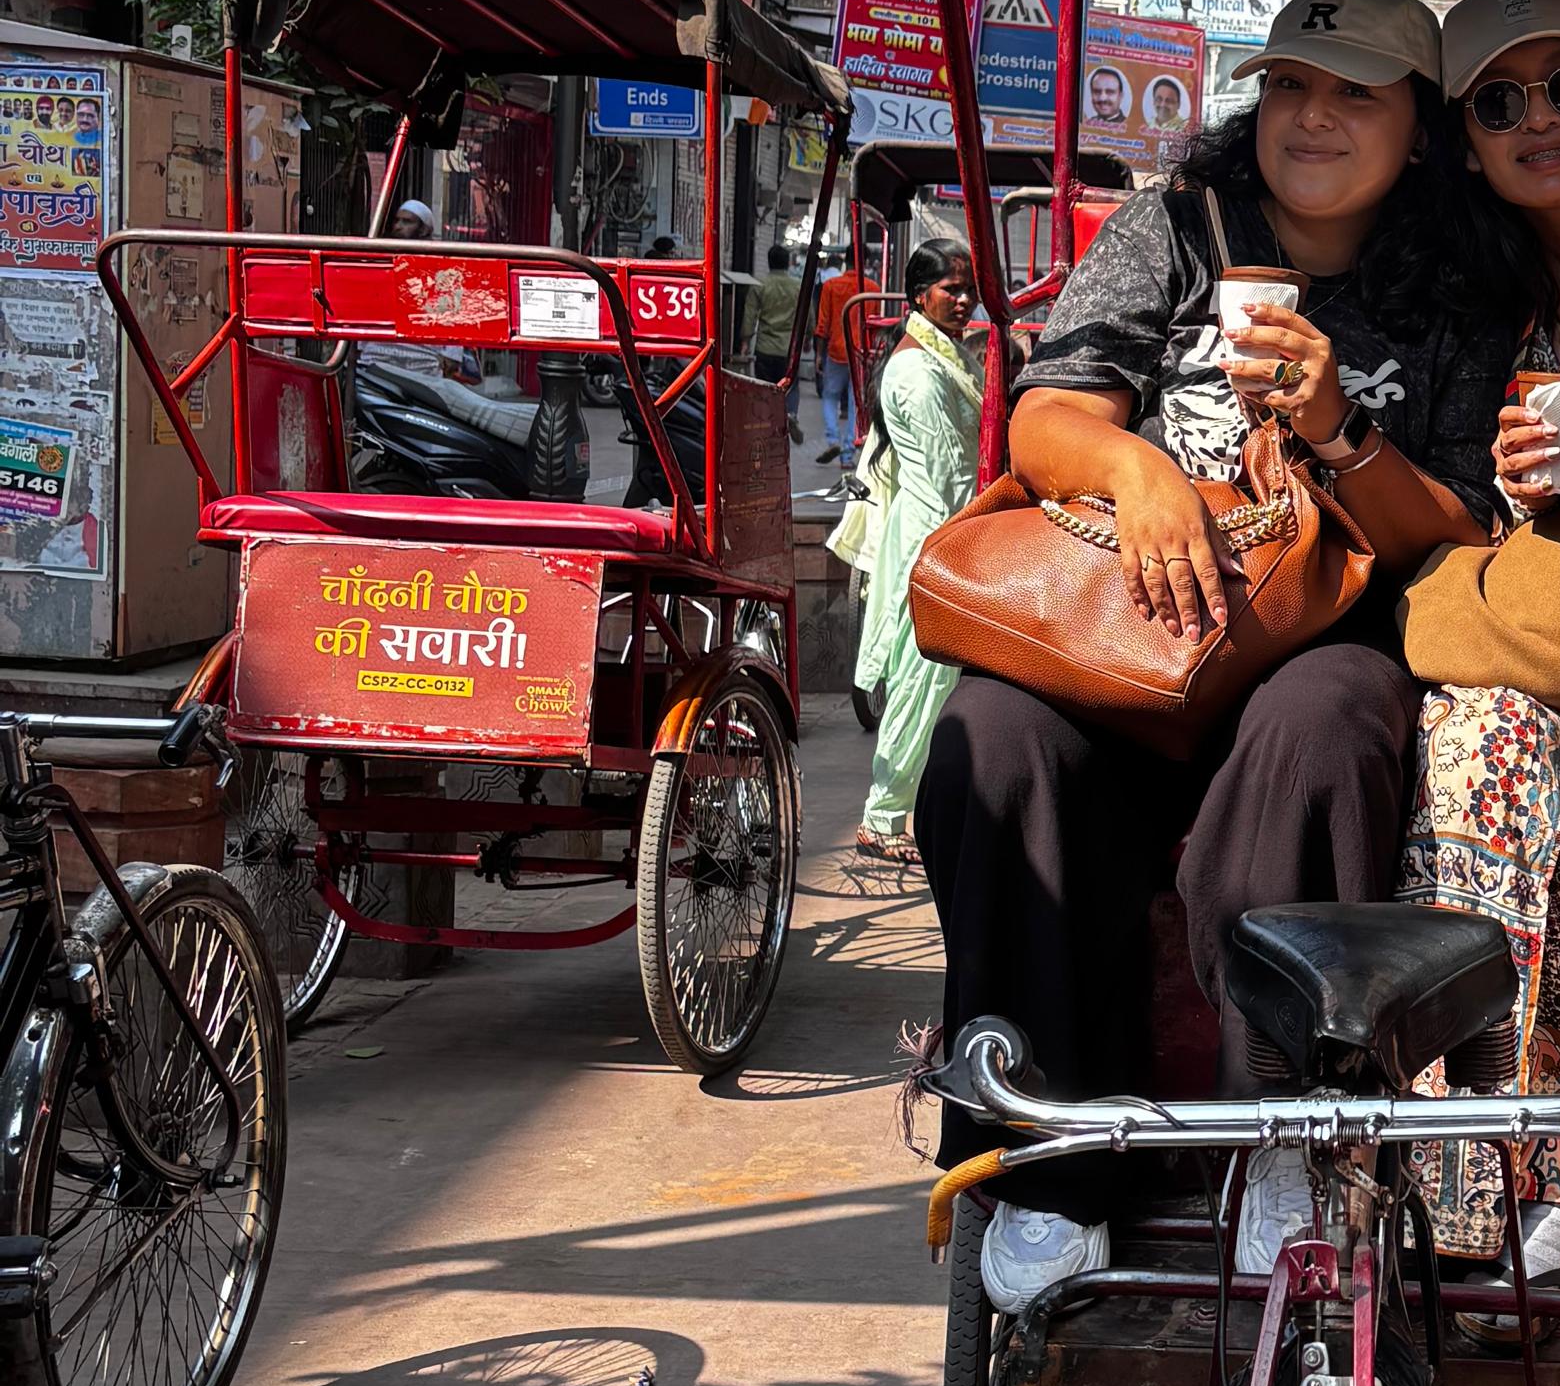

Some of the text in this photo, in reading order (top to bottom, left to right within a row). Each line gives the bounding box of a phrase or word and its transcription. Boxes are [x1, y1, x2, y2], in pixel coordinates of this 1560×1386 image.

[917, 16, 935, 26] 101
[1301, 2, 1338, 31] R
[846, 22, 880, 45] भव्य
[843, 53, 934, 85] हार्दिक स्वागत
[980, 52, 1057, 71] edestrian
[627, 87, 668, 106] Ends
[17, 130, 65, 167] चौथ
[320, 565, 530, 615] चाँदनी चौक
[314, 617, 528, 670] की सवारी!
[361, 674, 466, 693] CSPZ-CC-0132
[526, 685, 569, 697] OMAXE
[514, 694, 577, 717] Chowk
